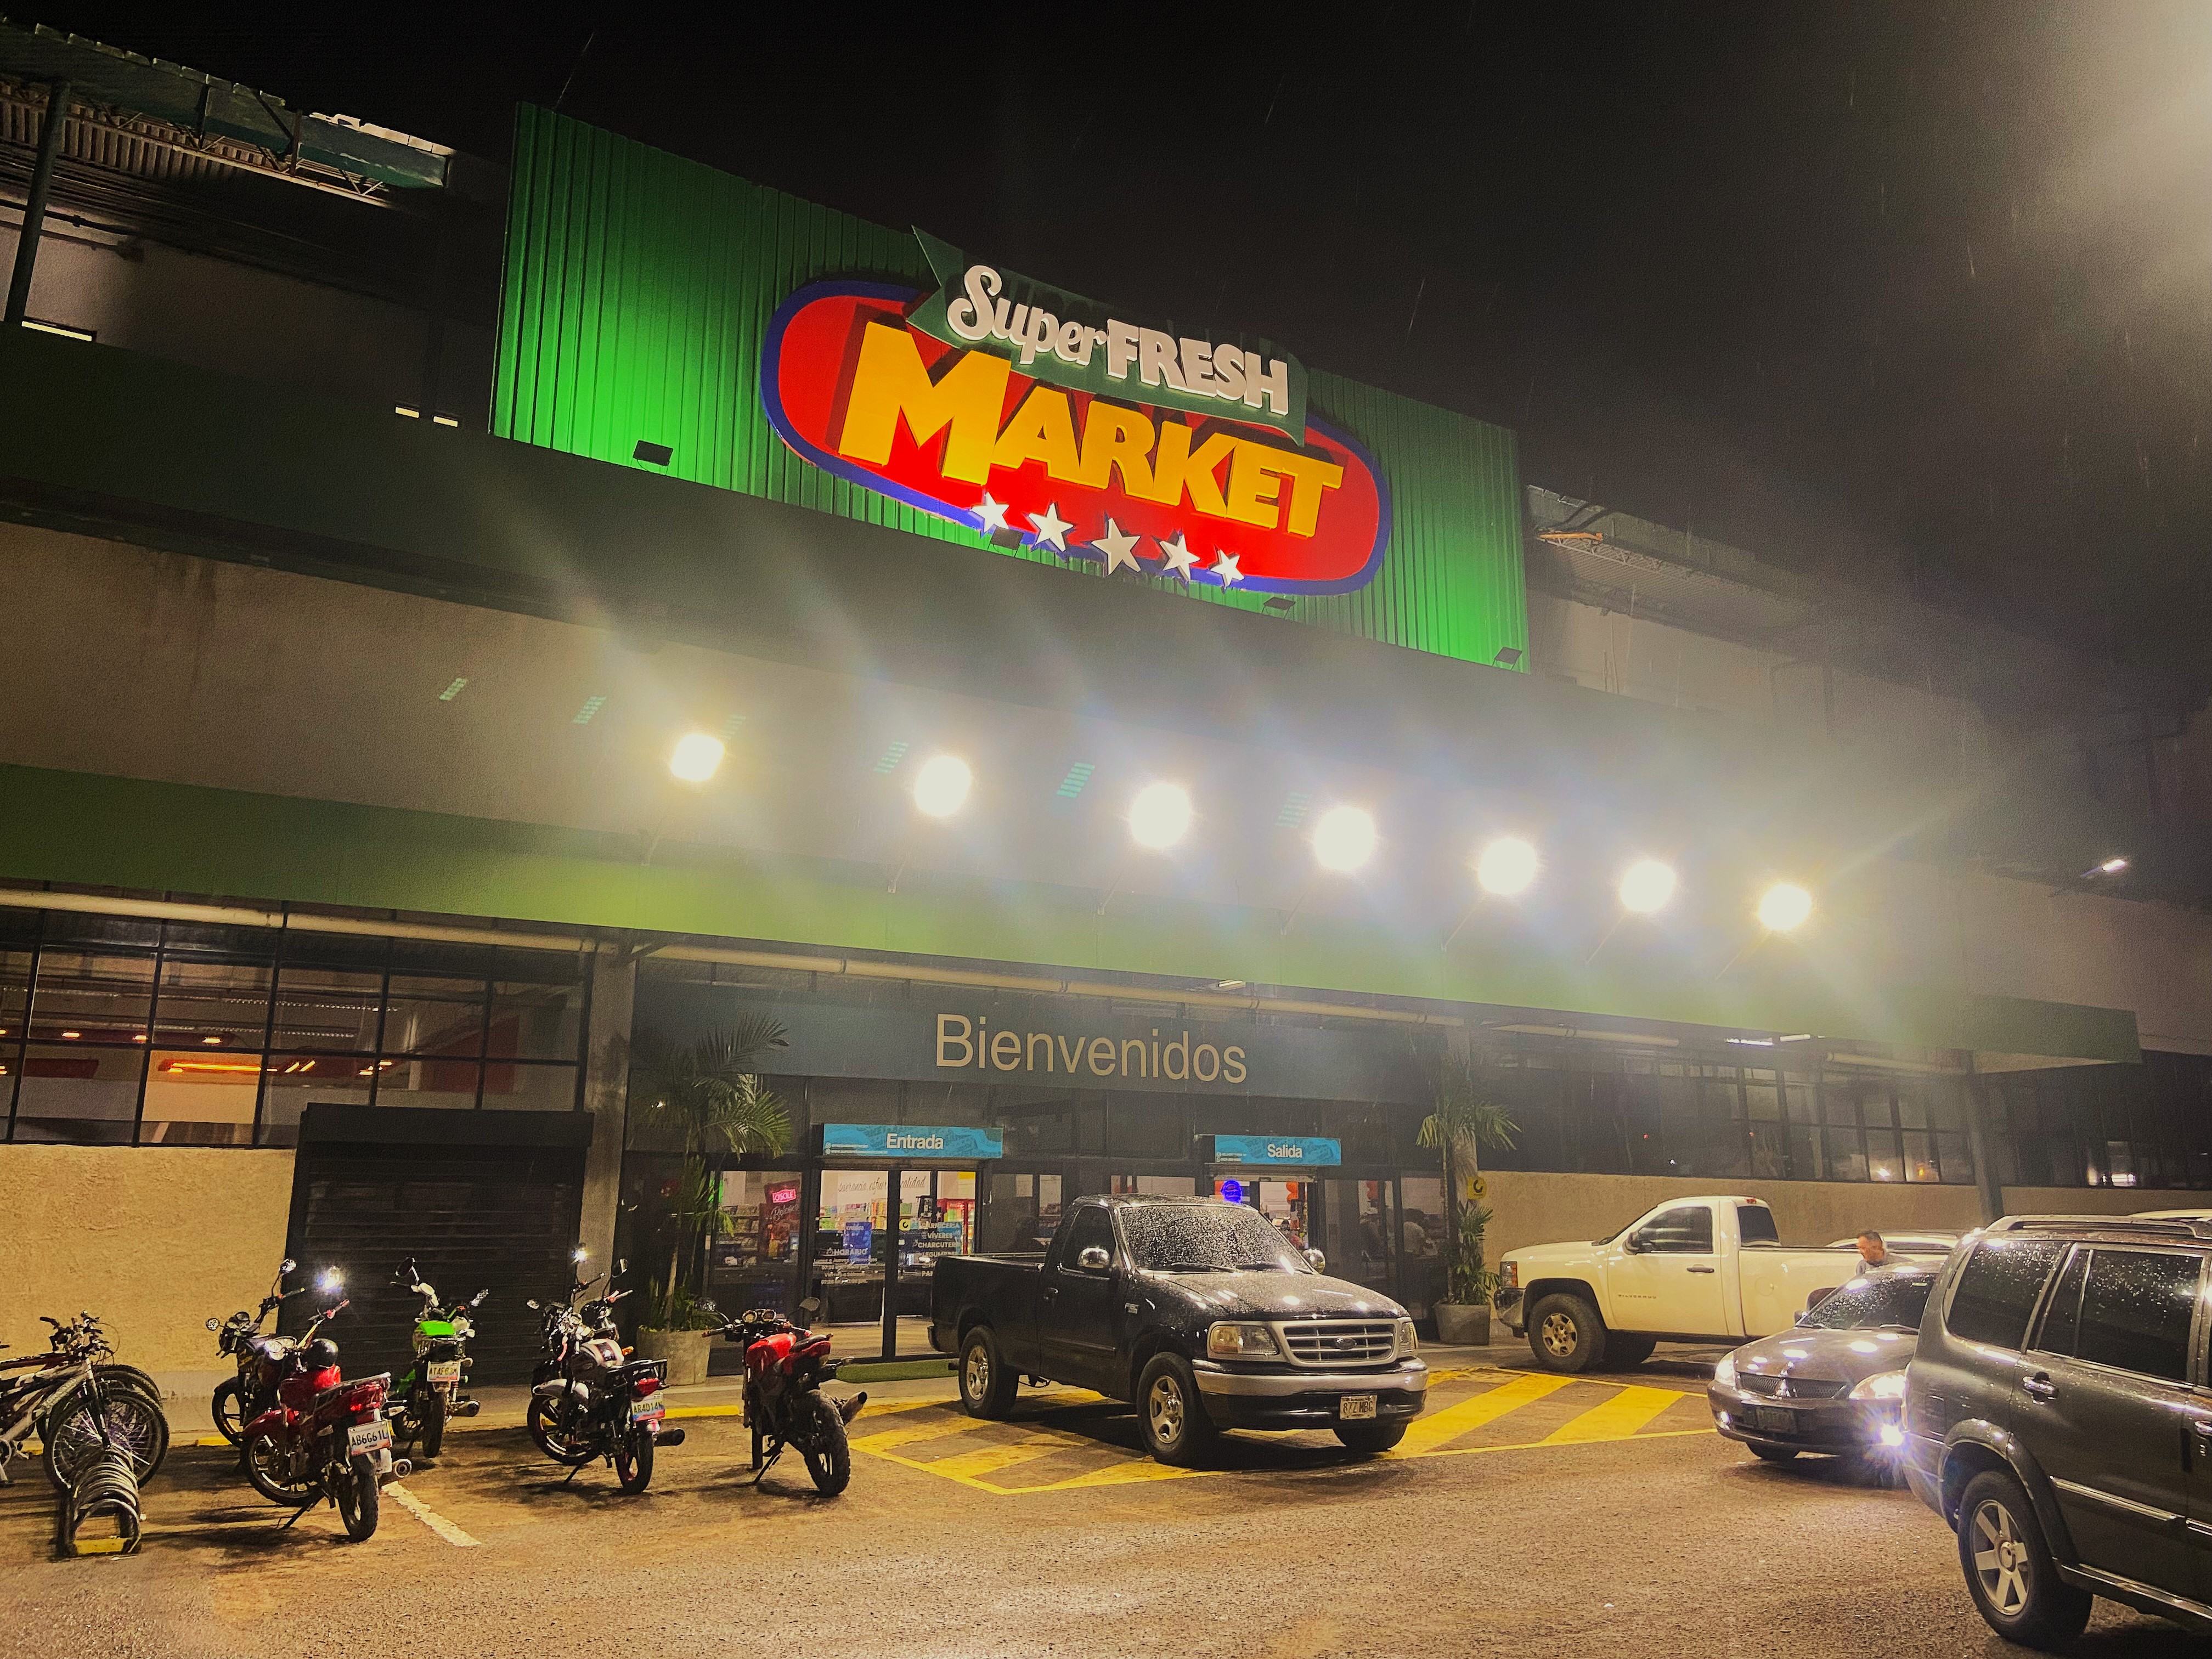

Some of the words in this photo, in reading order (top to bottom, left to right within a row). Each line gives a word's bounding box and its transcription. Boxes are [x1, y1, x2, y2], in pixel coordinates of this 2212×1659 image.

[838, 320, 1344, 538] MARKET
[936, 1013, 1248, 1084] Bienvenidos
[887, 1133, 944, 1150] Entrada
[1267, 1143, 1303, 1158] Salida
